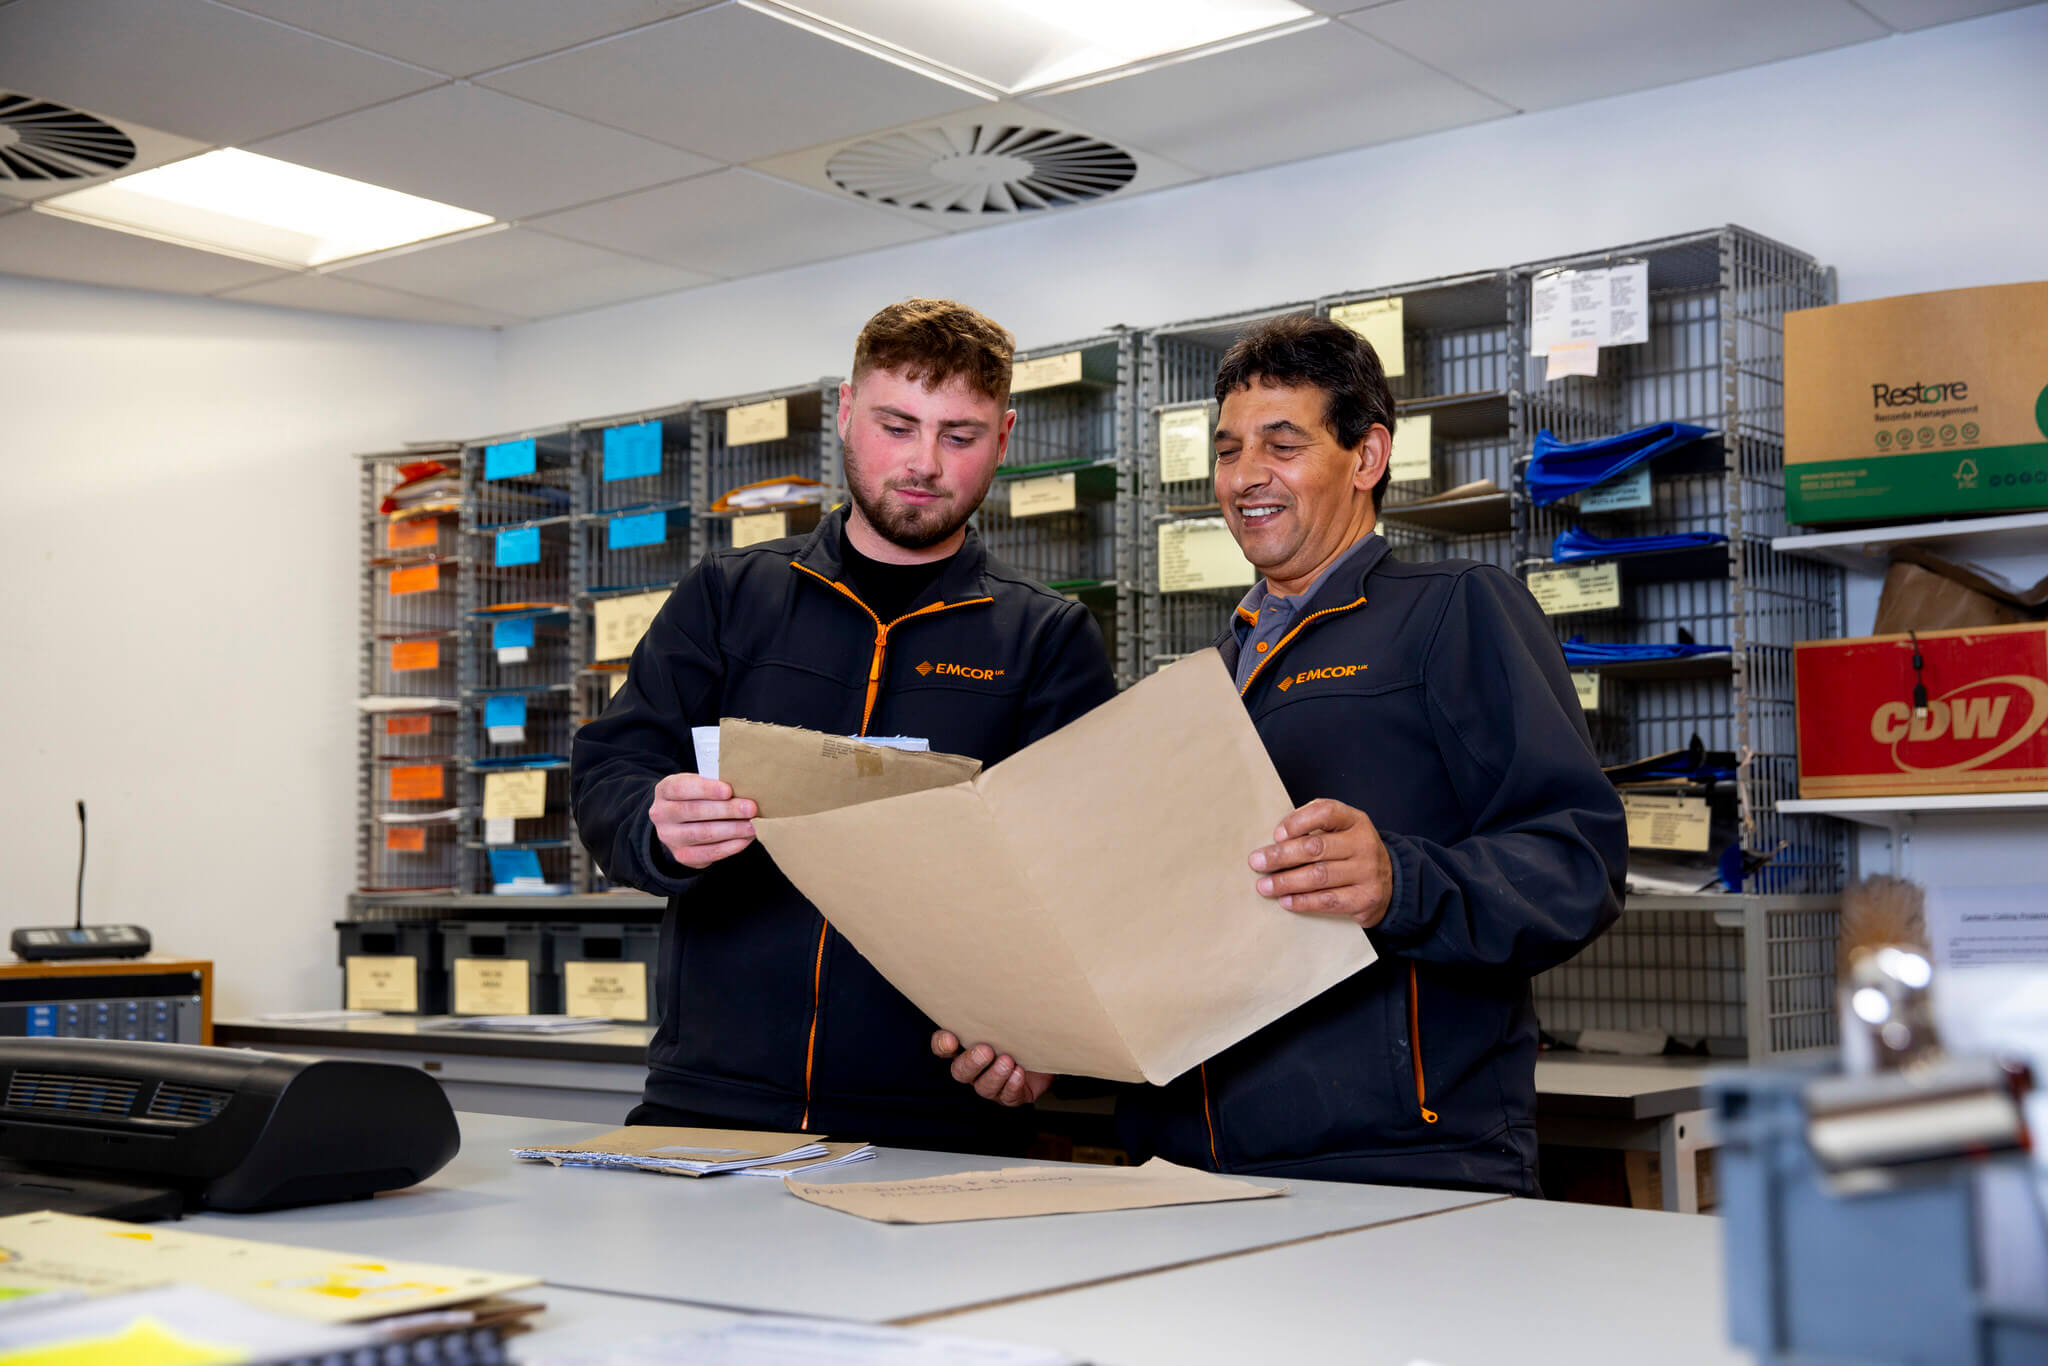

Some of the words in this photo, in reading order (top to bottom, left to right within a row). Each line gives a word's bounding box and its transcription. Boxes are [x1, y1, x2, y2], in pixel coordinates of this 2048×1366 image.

[1871, 381, 1968, 408] Restore
[1913, 405, 1979, 418] Management
[935, 663, 994, 681] EMCOR
[1296, 665, 1357, 684] EMCOR
[1871, 696, 2011, 744] CDW
